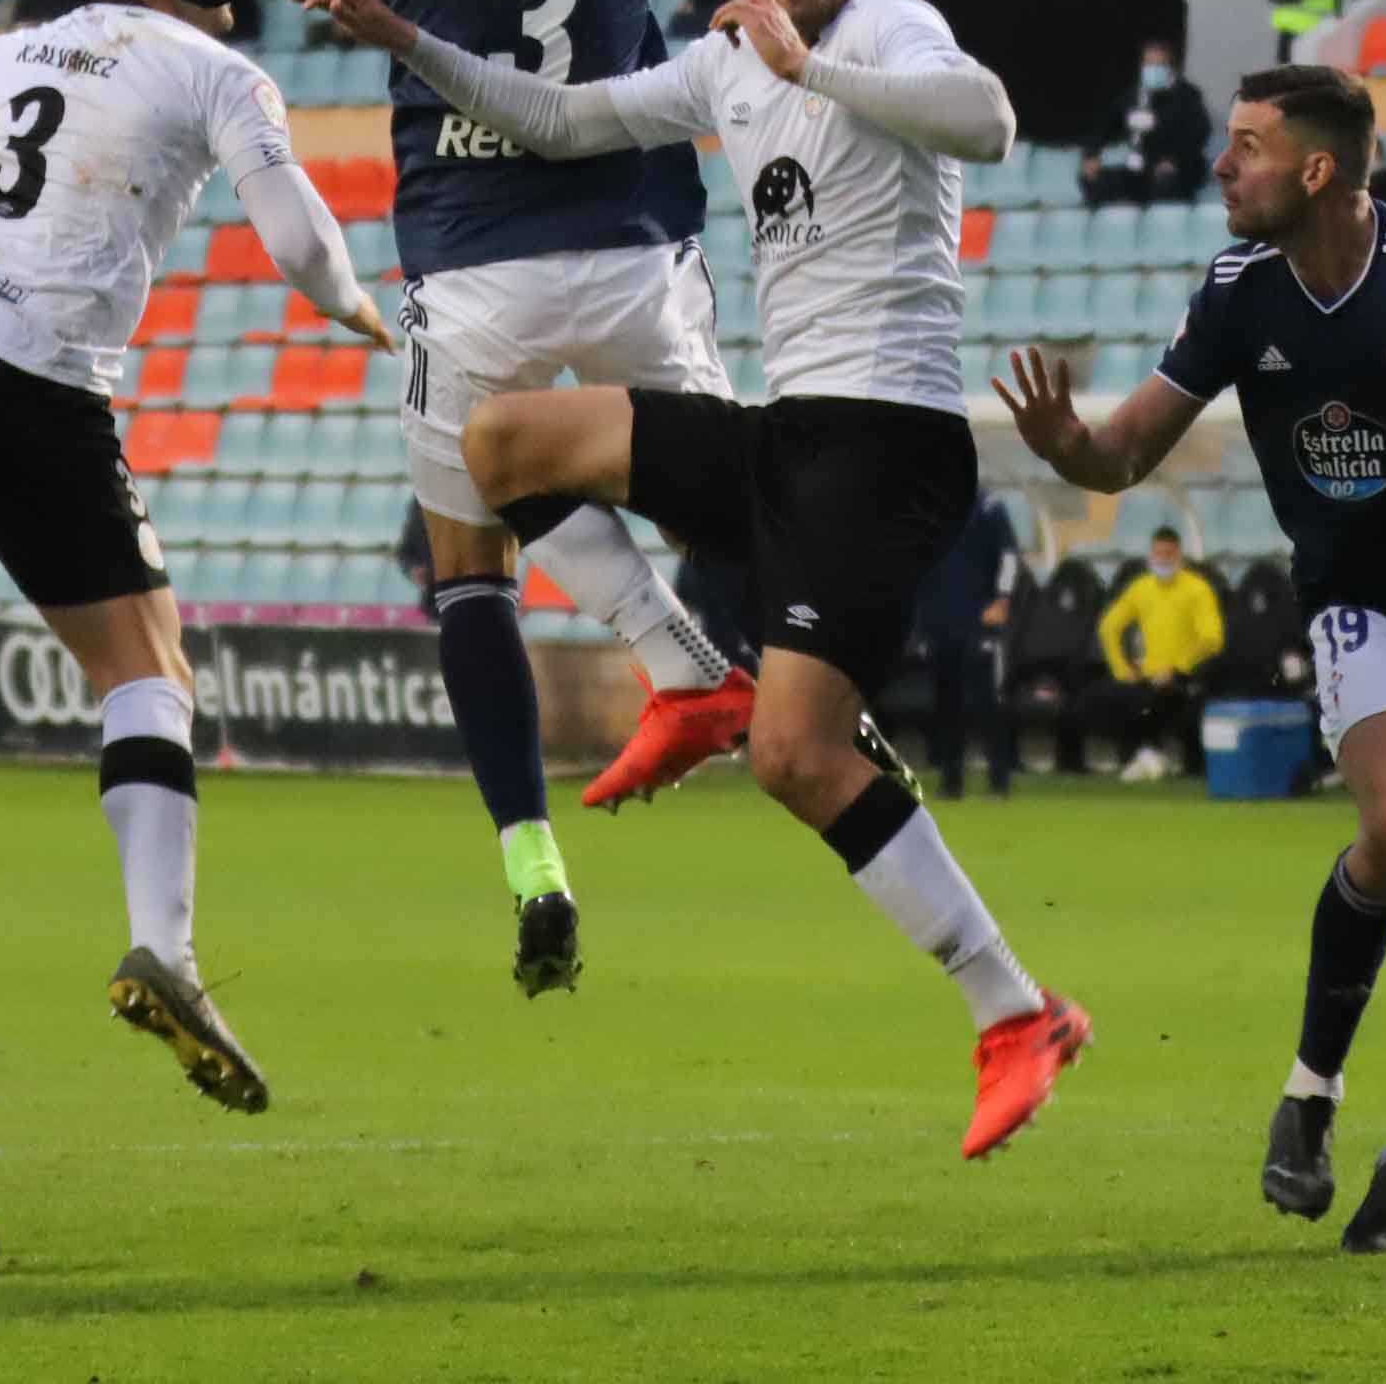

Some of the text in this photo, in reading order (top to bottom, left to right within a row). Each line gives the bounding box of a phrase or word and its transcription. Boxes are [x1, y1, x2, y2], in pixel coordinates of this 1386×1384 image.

[1301, 429, 1385, 454] Estrella
[1310, 453, 1382, 478] Galicia
[1322, 607, 1369, 665] 19
